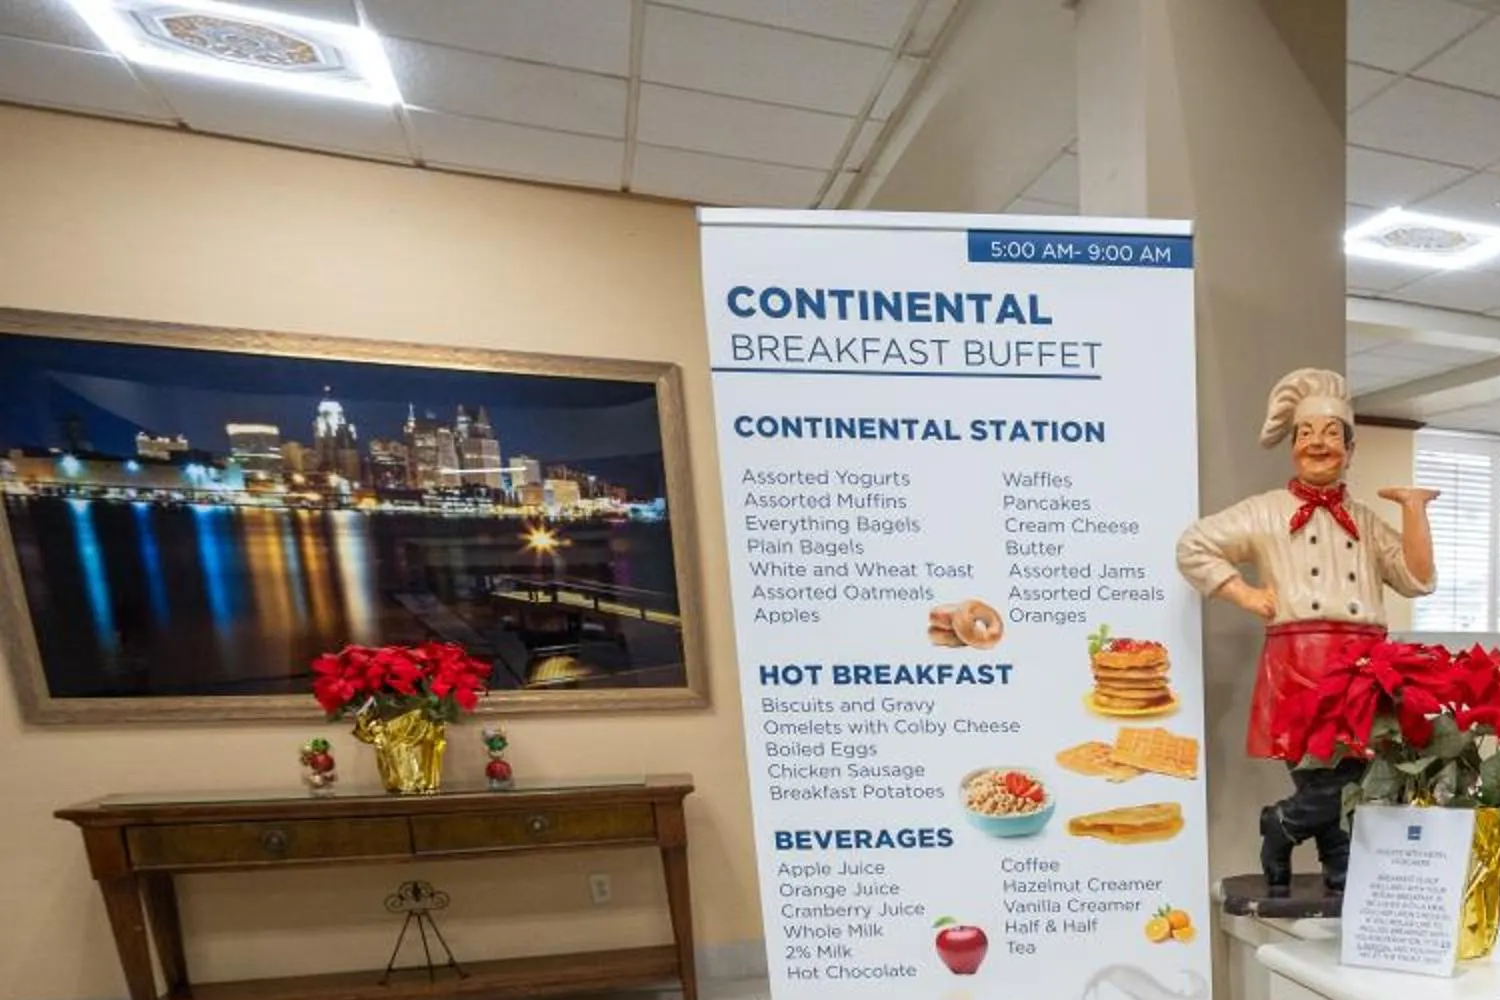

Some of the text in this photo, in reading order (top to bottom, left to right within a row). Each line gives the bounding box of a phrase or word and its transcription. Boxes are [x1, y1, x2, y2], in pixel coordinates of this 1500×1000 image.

[992, 241, 1035, 258] 5:00
[1088, 244, 1133, 261] 9:00
[1140, 245, 1170, 262] AM
[727, 286, 1052, 325] CONTINENTAL
[732, 334, 1102, 368] BREAKFAST BUFFET
[734, 416, 1104, 442] CONTINENTAL STATION
[742, 469, 910, 488] Assorted Yogurts
[1002, 472, 1072, 488] Waffles
[744, 492, 907, 509] Assorted Muffins
[1003, 495, 1091, 511] Pancakes
[745, 515, 921, 535] Everything Bagels
[1005, 517, 1139, 535] Cream Cheese
[747, 538, 864, 557] Plain Bagels
[1006, 540, 1064, 556] Butter
[749, 562, 974, 578] White and Wheat Toast
[1009, 563, 1145, 579] Assorted Jams
[752, 584, 934, 601] Assorted Oatmeals
[1008, 585, 1164, 601] Assorted Cereals
[754, 608, 820, 624] Apples
[1009, 607, 1086, 625] Oranges
[760, 664, 1013, 685] HOT BREAKFAST
[762, 697, 935, 715] Biscuits and Gravy
[763, 719, 1020, 736] Omelets with Colby Cheese
[766, 741, 877, 758] Boiled Eggs
[768, 764, 925, 780] Chicken Sausage
[770, 784, 944, 800] Breakfast Potatoes
[775, 828, 953, 850] BEVERAGES
[778, 861, 885, 878] Apple Juice
[1001, 857, 1060, 873] Coffee
[779, 882, 900, 899] Orange Juice
[1003, 877, 1162, 893] Hazelnut Creamer
[781, 902, 925, 919] Cranberry Juice
[1003, 898, 1140, 913] Vanilla Creamer
[783, 923, 883, 939] Whole Milk
[1005, 918, 1098, 935] Half & Half
[785, 944, 852, 960] 2% Milk
[1007, 941, 1036, 954] Tea
[788, 964, 917, 979] Hot Chocolate
